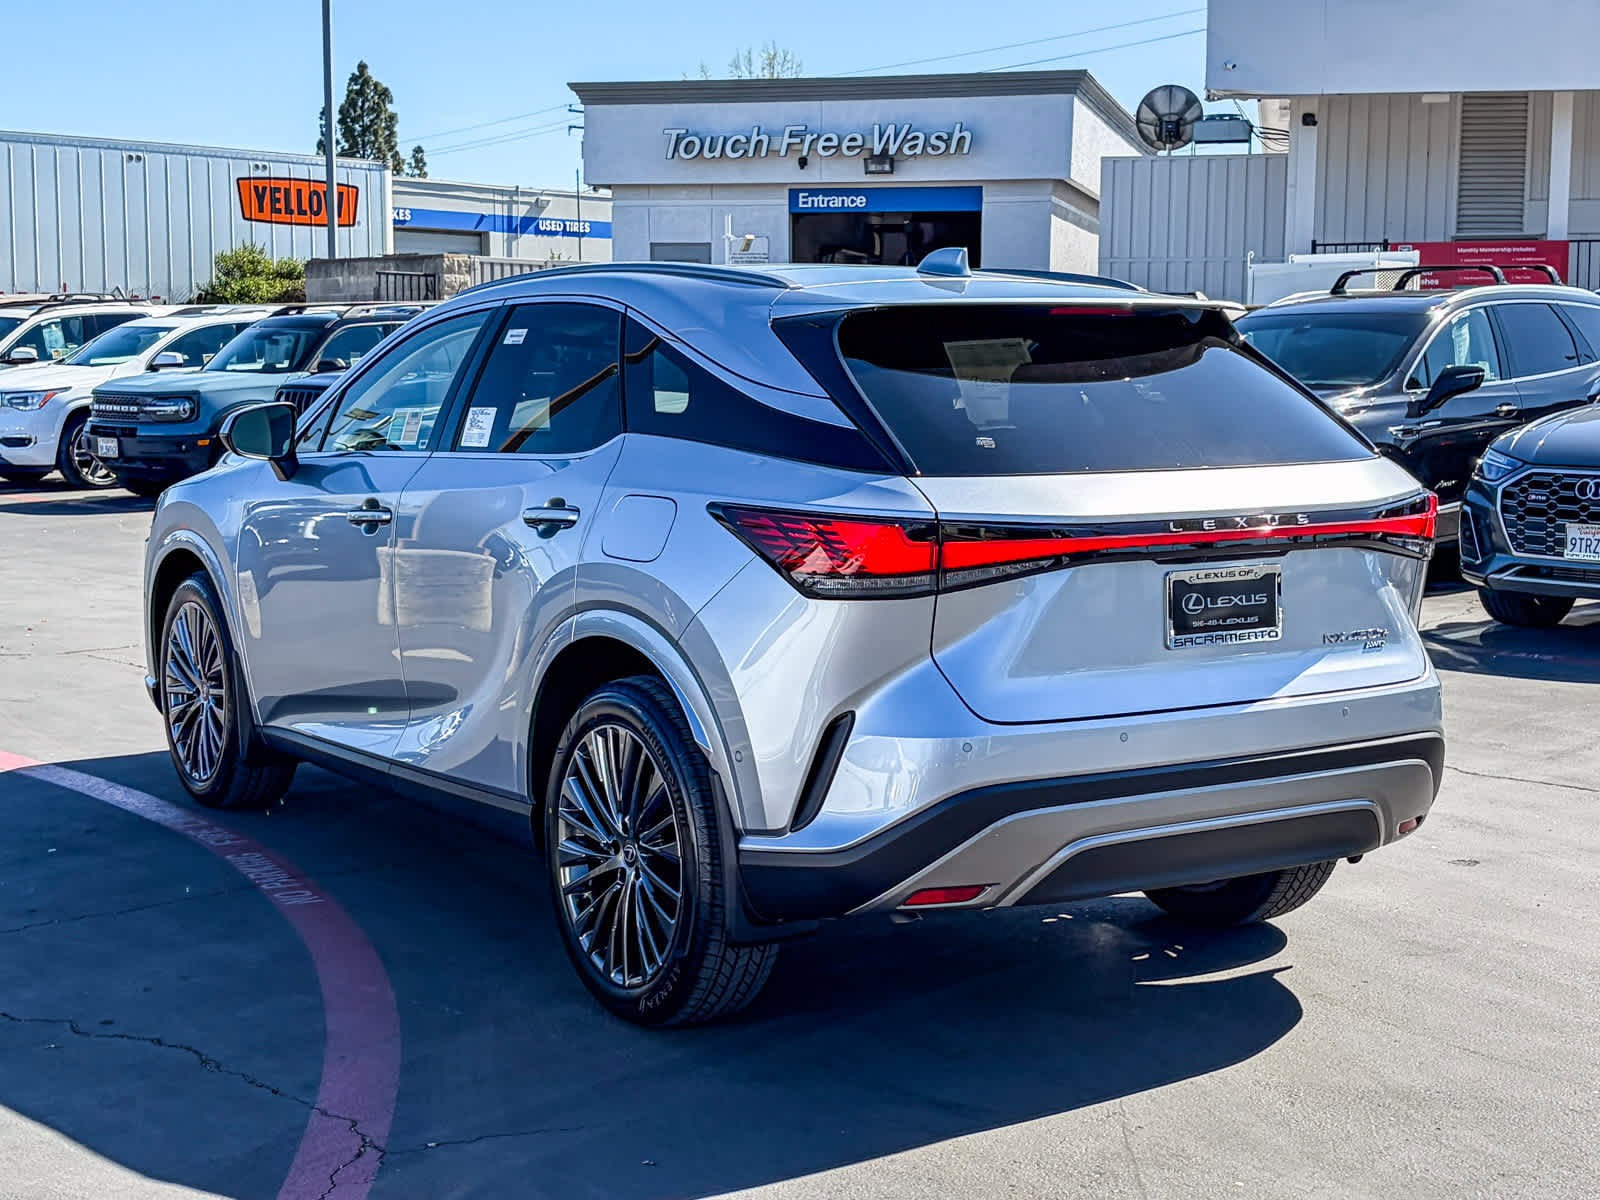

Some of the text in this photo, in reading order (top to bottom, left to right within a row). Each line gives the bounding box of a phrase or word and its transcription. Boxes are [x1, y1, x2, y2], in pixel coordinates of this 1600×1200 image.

[663, 122, 973, 160] Touch Free Wash
[798, 192, 867, 208] Entrance
[539, 219, 591, 233] USED TIRES
[1169, 514, 1310, 532] LEXUS
[1196, 568, 1254, 580] LEXUS OF
[1207, 594, 1267, 608] LEXUS
[1173, 629, 1279, 648] SACRAMENTO
